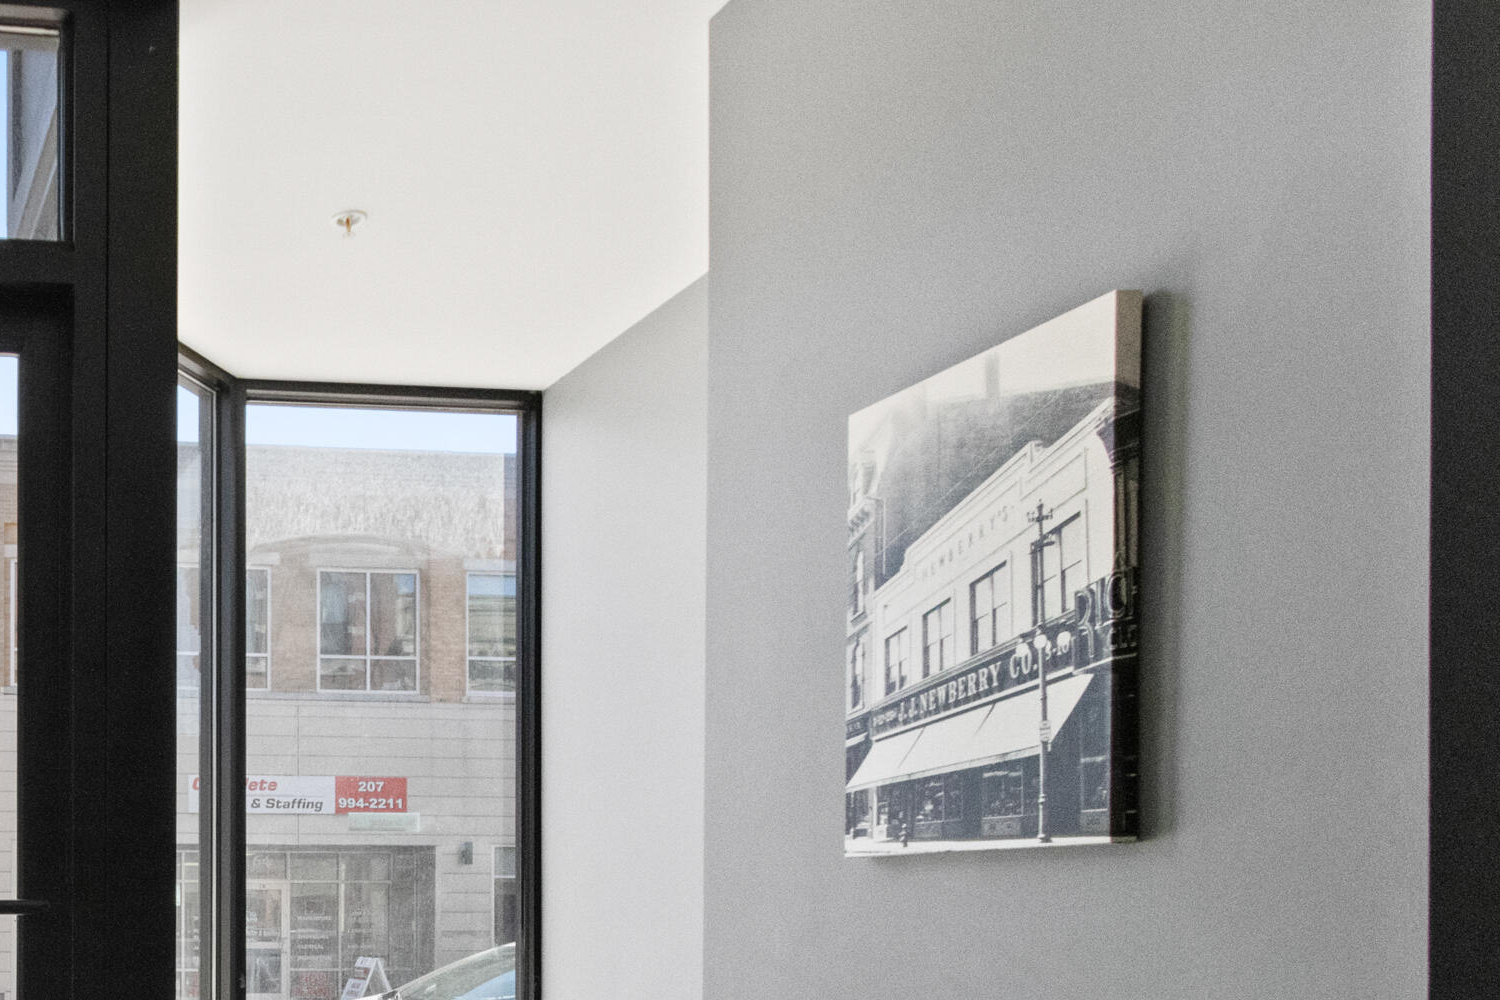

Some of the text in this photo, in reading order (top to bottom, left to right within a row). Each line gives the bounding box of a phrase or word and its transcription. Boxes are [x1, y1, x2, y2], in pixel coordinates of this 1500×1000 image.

[358, 780, 385, 793] 207
[250, 797, 324, 812] & Staffing
[338, 797, 404, 810] 994-2211
